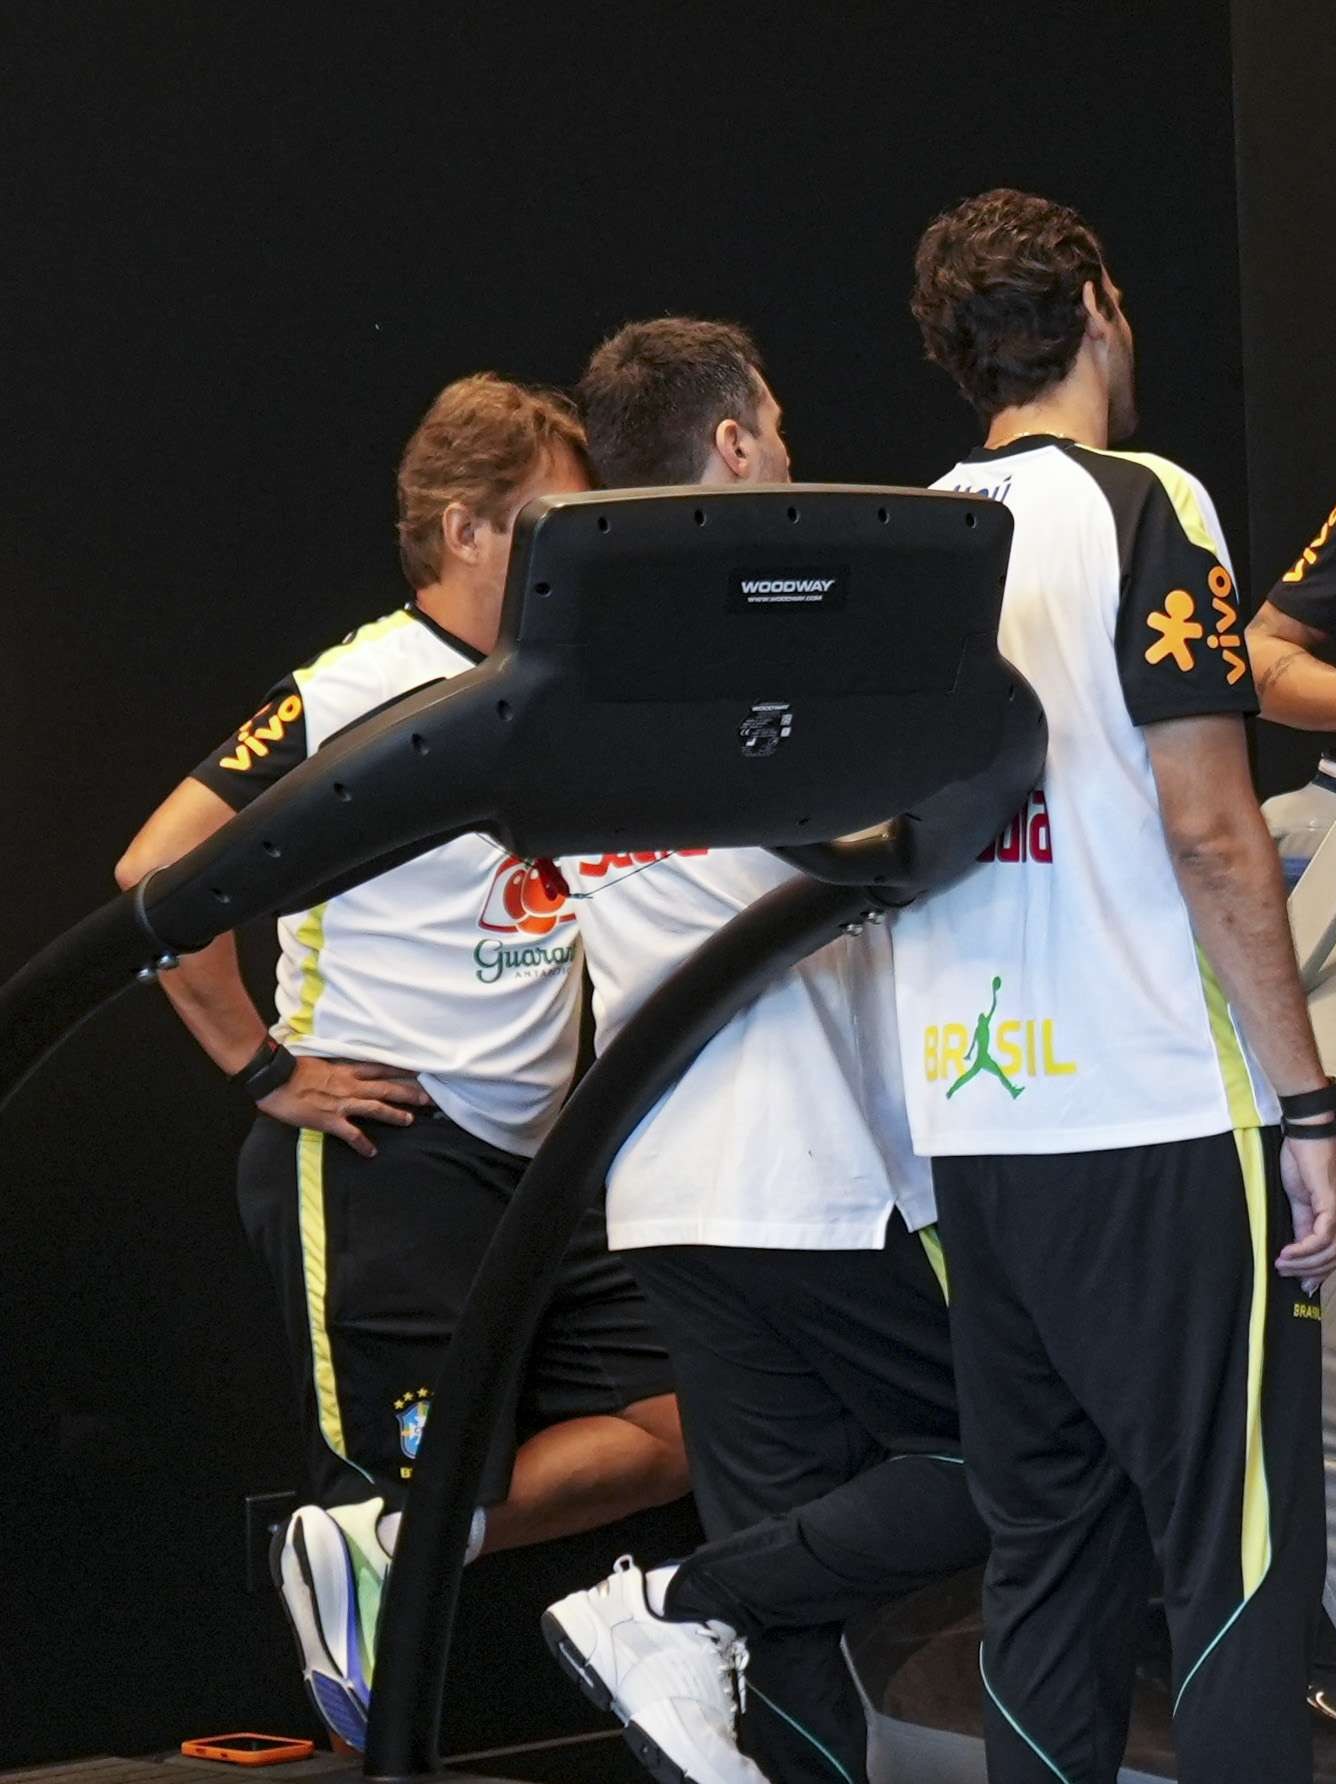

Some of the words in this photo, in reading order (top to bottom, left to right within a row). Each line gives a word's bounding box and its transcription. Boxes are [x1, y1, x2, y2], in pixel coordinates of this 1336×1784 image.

[741, 580, 835, 594] WOODWAY
[1206, 566, 1246, 685] vivo
[219, 694, 302, 771] vivo
[473, 938, 577, 984] Guaran
